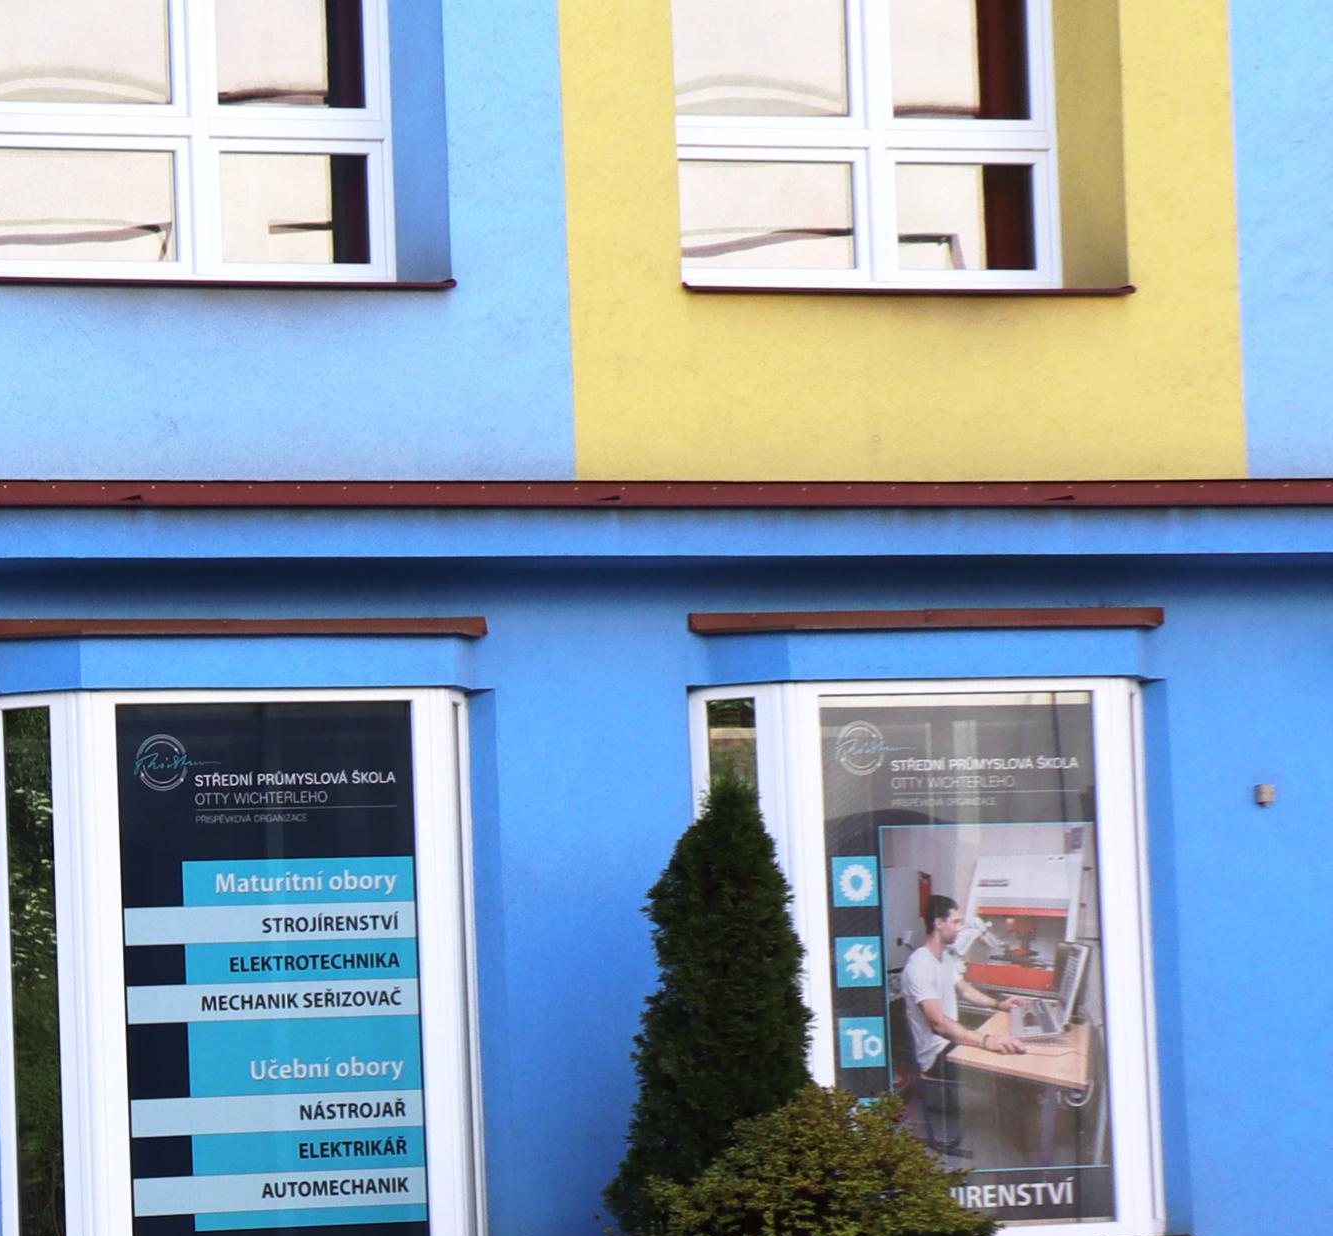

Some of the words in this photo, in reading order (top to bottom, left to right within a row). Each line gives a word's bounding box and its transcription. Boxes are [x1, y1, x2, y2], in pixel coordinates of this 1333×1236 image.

[890, 757, 945, 772] STŘEDNÍ
[948, 756, 1034, 771] PRŮMYSLOVÁ
[1036, 755, 1079, 769] ŠKOLA
[194, 771, 253, 787] STŘEDNÍ
[257, 770, 348, 786] PRŮMYSLOVÁ
[351, 771, 396, 785] ŠKOLA
[891, 777, 924, 790] OTTY
[194, 792, 230, 806] OTTY
[233, 791, 328, 804] WICHTERLEHO
[215, 871, 323, 893] Maturitní
[329, 870, 398, 895] obory
[262, 911, 400, 933] STROJÍRENSTVÍ
[229, 952, 400, 973] ELEKTROTECHNIKA
[201, 992, 298, 1012] MECHANIK
[303, 987, 402, 1009] SEŘIZOVAČ
[250, 1057, 330, 1080] Učební
[336, 1056, 405, 1081] obory
[299, 1098, 406, 1121] NÁSTROJAŘ
[299, 1136, 407, 1159] ELEKTRIKÁŘ
[261, 1176, 409, 1199] AUTOMECHANIK
